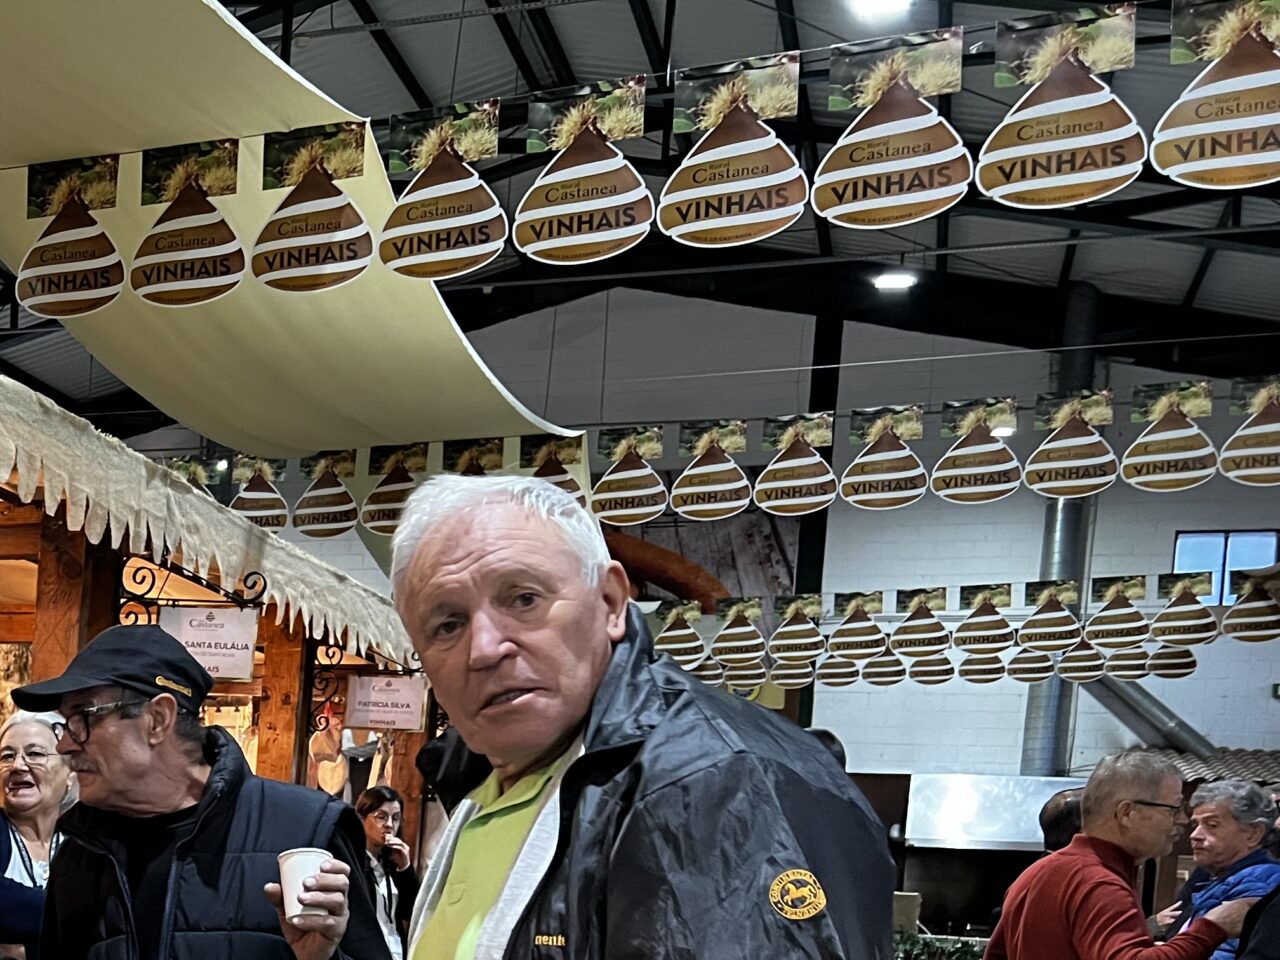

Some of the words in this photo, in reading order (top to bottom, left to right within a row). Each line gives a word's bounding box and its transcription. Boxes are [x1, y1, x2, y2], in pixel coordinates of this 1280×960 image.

[1016, 120, 1104, 141] Castanea
[849, 142, 931, 163] Castanea
[1174, 128, 1280, 161] VINHA
[996, 145, 1126, 183] VINHAIS
[692, 164, 769, 184] Castanea
[831, 165, 952, 203] VINHAIS
[545, 184, 617, 203] Castanea
[406, 203, 473, 221] Castanea
[675, 187, 789, 223] VINHAIS
[277, 220, 341, 237] Castanea
[530, 206, 636, 241] VINHAIS
[155, 236, 215, 250] Castanea
[392, 225, 490, 257] VINHAIS
[40, 249, 96, 263] Castanea
[264, 242, 358, 270] VINHAIS
[142, 258, 231, 284] VINHAIS
[28, 270, 111, 295] VINHAIS
[1133, 457, 1207, 475] VINHAIS
[1231, 454, 1279, 469] VINH
[942, 471, 1012, 488] VINHAIS
[1036, 464, 1107, 482] VINHAIS
[764, 484, 827, 500] VINHAIS
[851, 477, 917, 494] VINHAIS
[599, 495, 658, 511] VINHAIS
[680, 490, 742, 506] VINHAIS
[299, 511, 351, 525] VINHAIS
[185, 641, 212, 649] SANTA
[214, 641, 249, 650] EULÁLIA
[390, 701, 411, 709] SILVA
